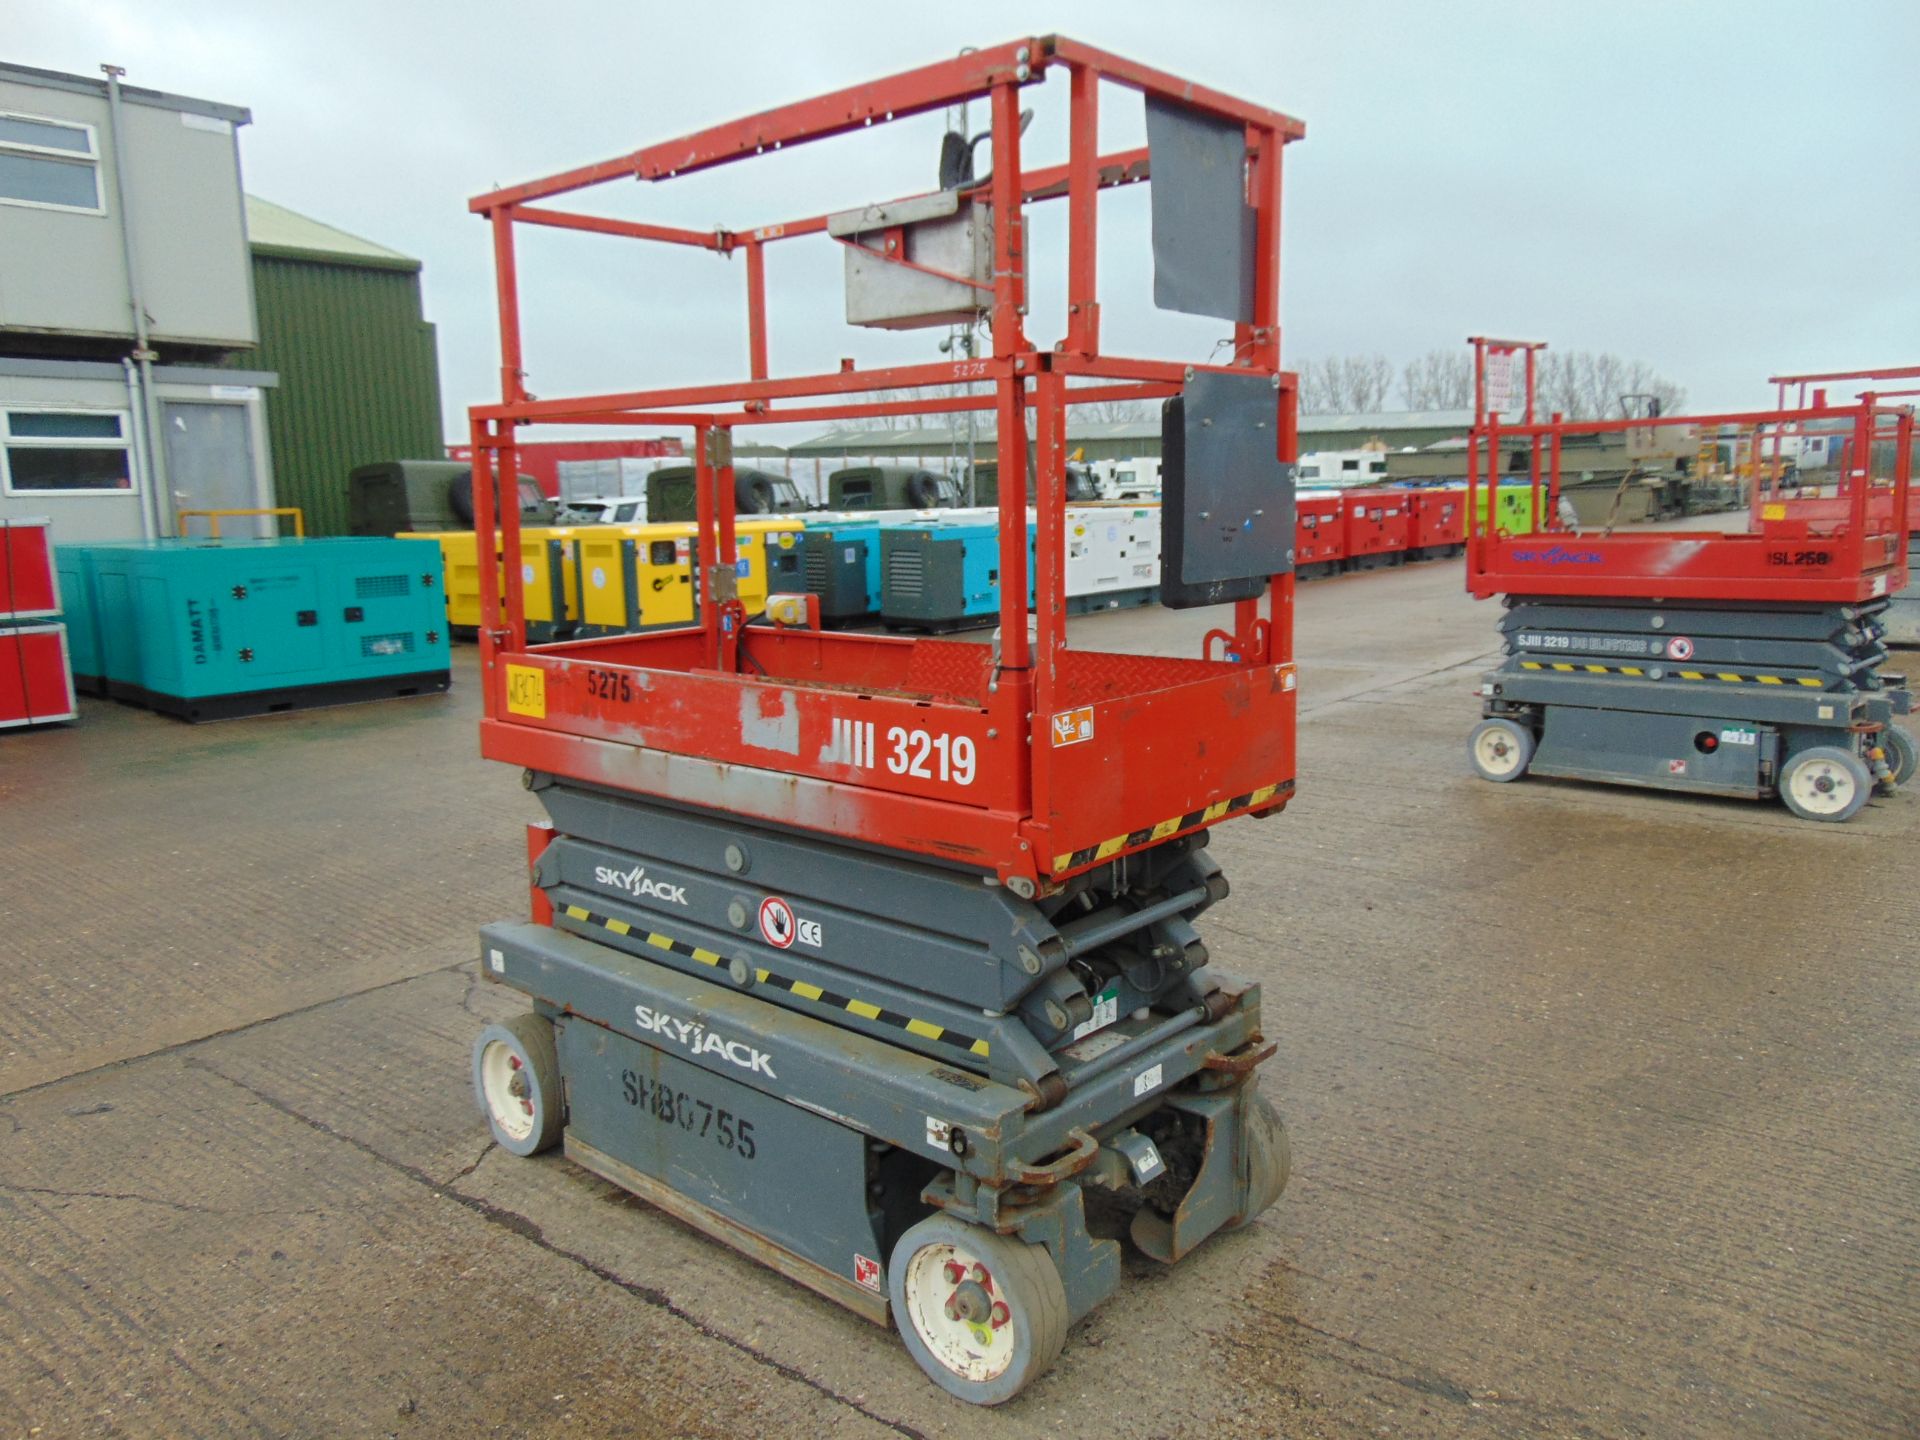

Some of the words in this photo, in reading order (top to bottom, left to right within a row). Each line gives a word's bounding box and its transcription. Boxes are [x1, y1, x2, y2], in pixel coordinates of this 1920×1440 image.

[953, 362, 988, 378] 5275
[187, 599, 207, 665] DAMATT
[1544, 635, 1569, 648] 3219
[587, 669, 631, 702] 5275
[887, 726, 976, 785] 3219
[595, 865, 689, 906] SKYJACK
[635, 1004, 778, 1080] SKYJACK
